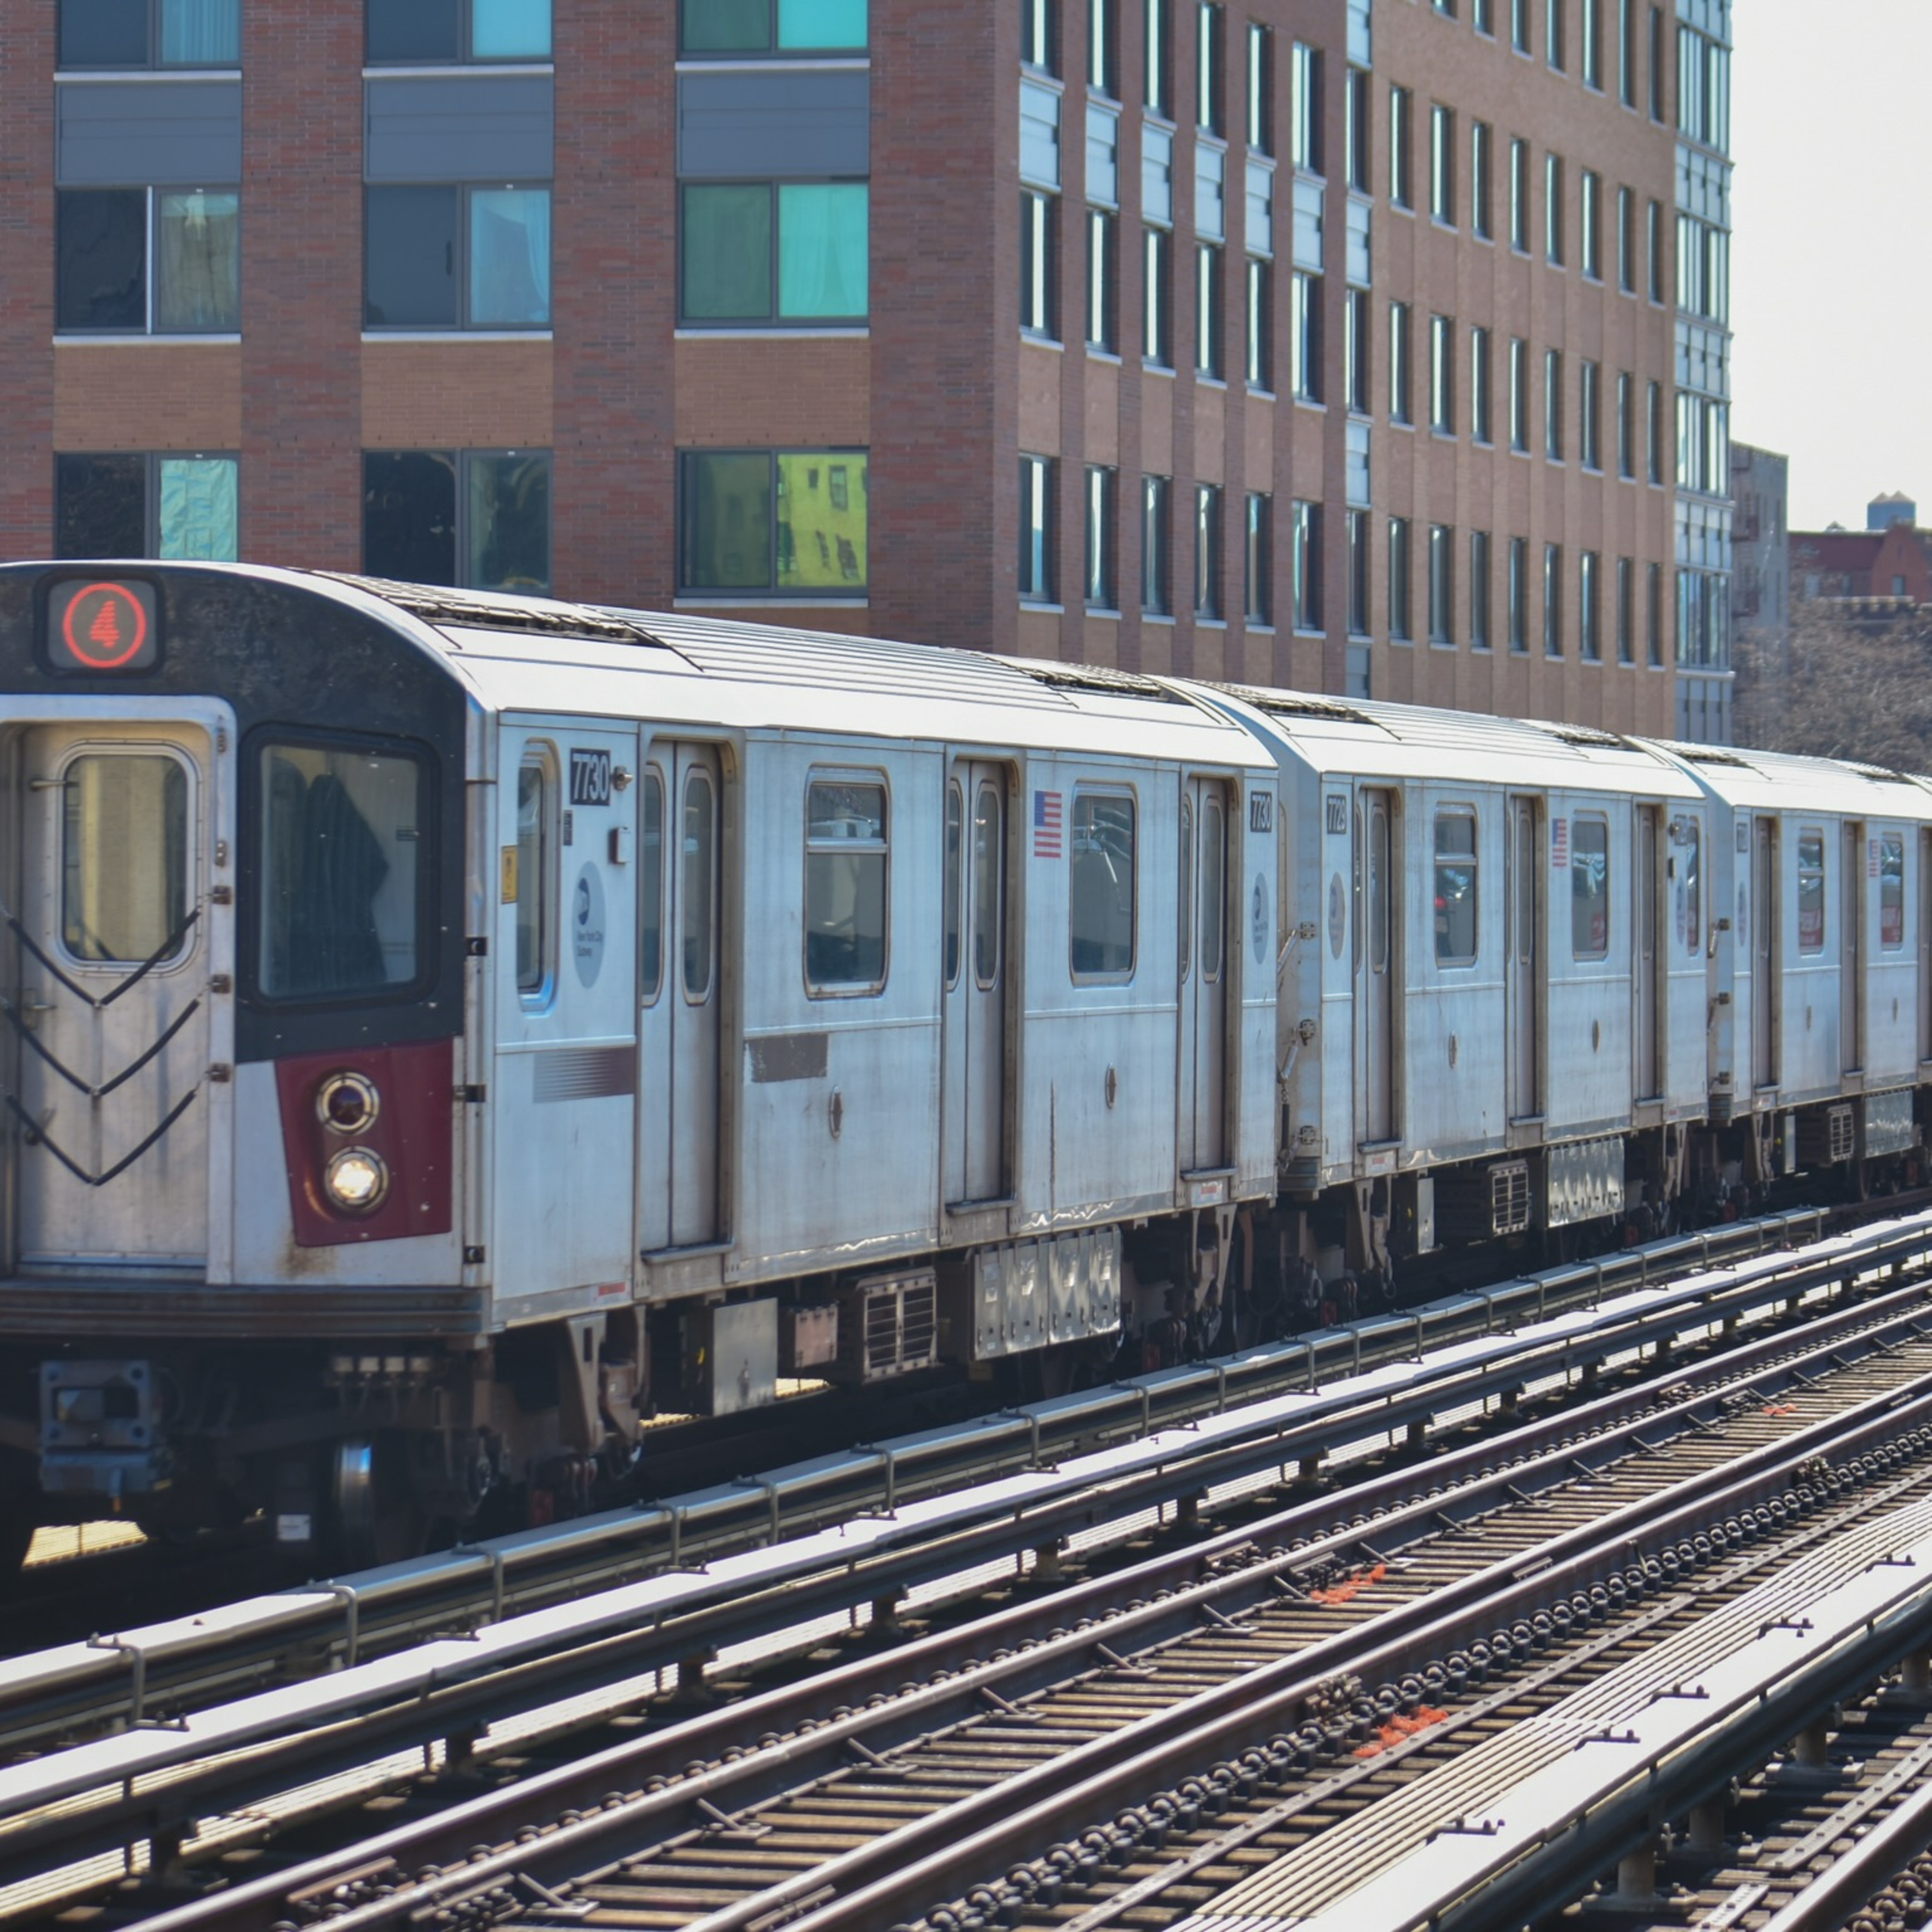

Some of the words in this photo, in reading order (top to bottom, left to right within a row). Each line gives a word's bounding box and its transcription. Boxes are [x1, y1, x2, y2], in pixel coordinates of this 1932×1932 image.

[90, 601, 119, 647] 4
[573, 753, 609, 800] 7730
[1252, 795, 1271, 828] 7730
